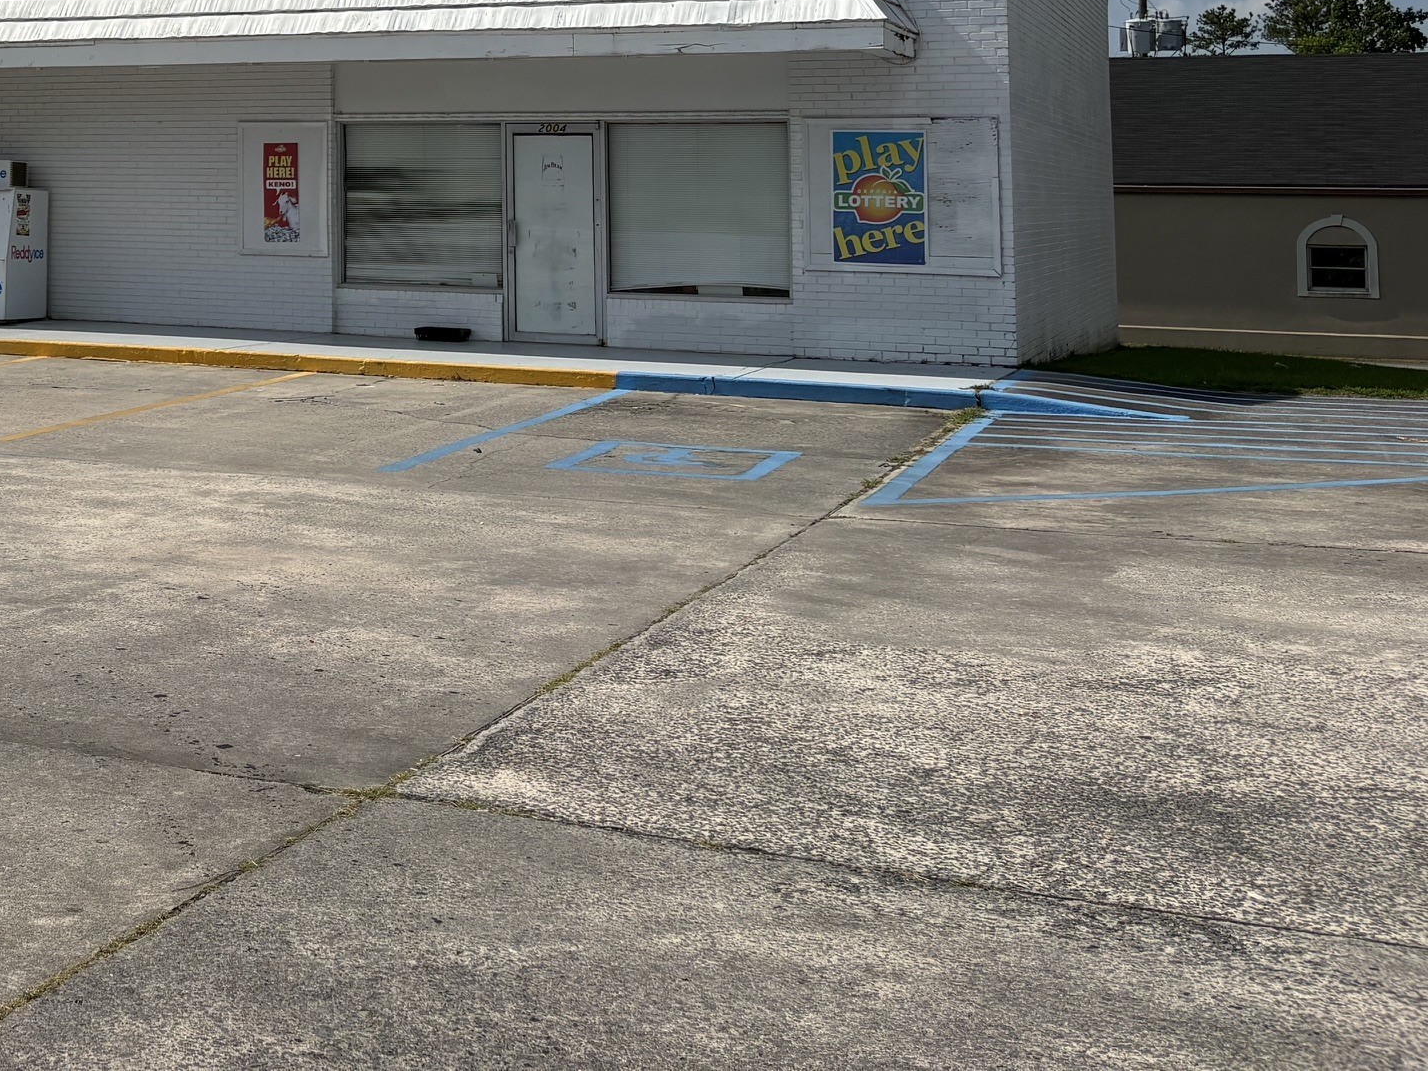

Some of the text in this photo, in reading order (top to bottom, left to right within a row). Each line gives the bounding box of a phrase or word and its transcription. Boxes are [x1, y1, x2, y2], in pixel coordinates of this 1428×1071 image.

[538, 123, 567, 132] 2004
[268, 155, 293, 166] PLAY
[833, 136, 924, 185] play
[266, 167, 294, 178] HERE!
[838, 195, 921, 209] LOTTERY
[833, 220, 925, 260] here
